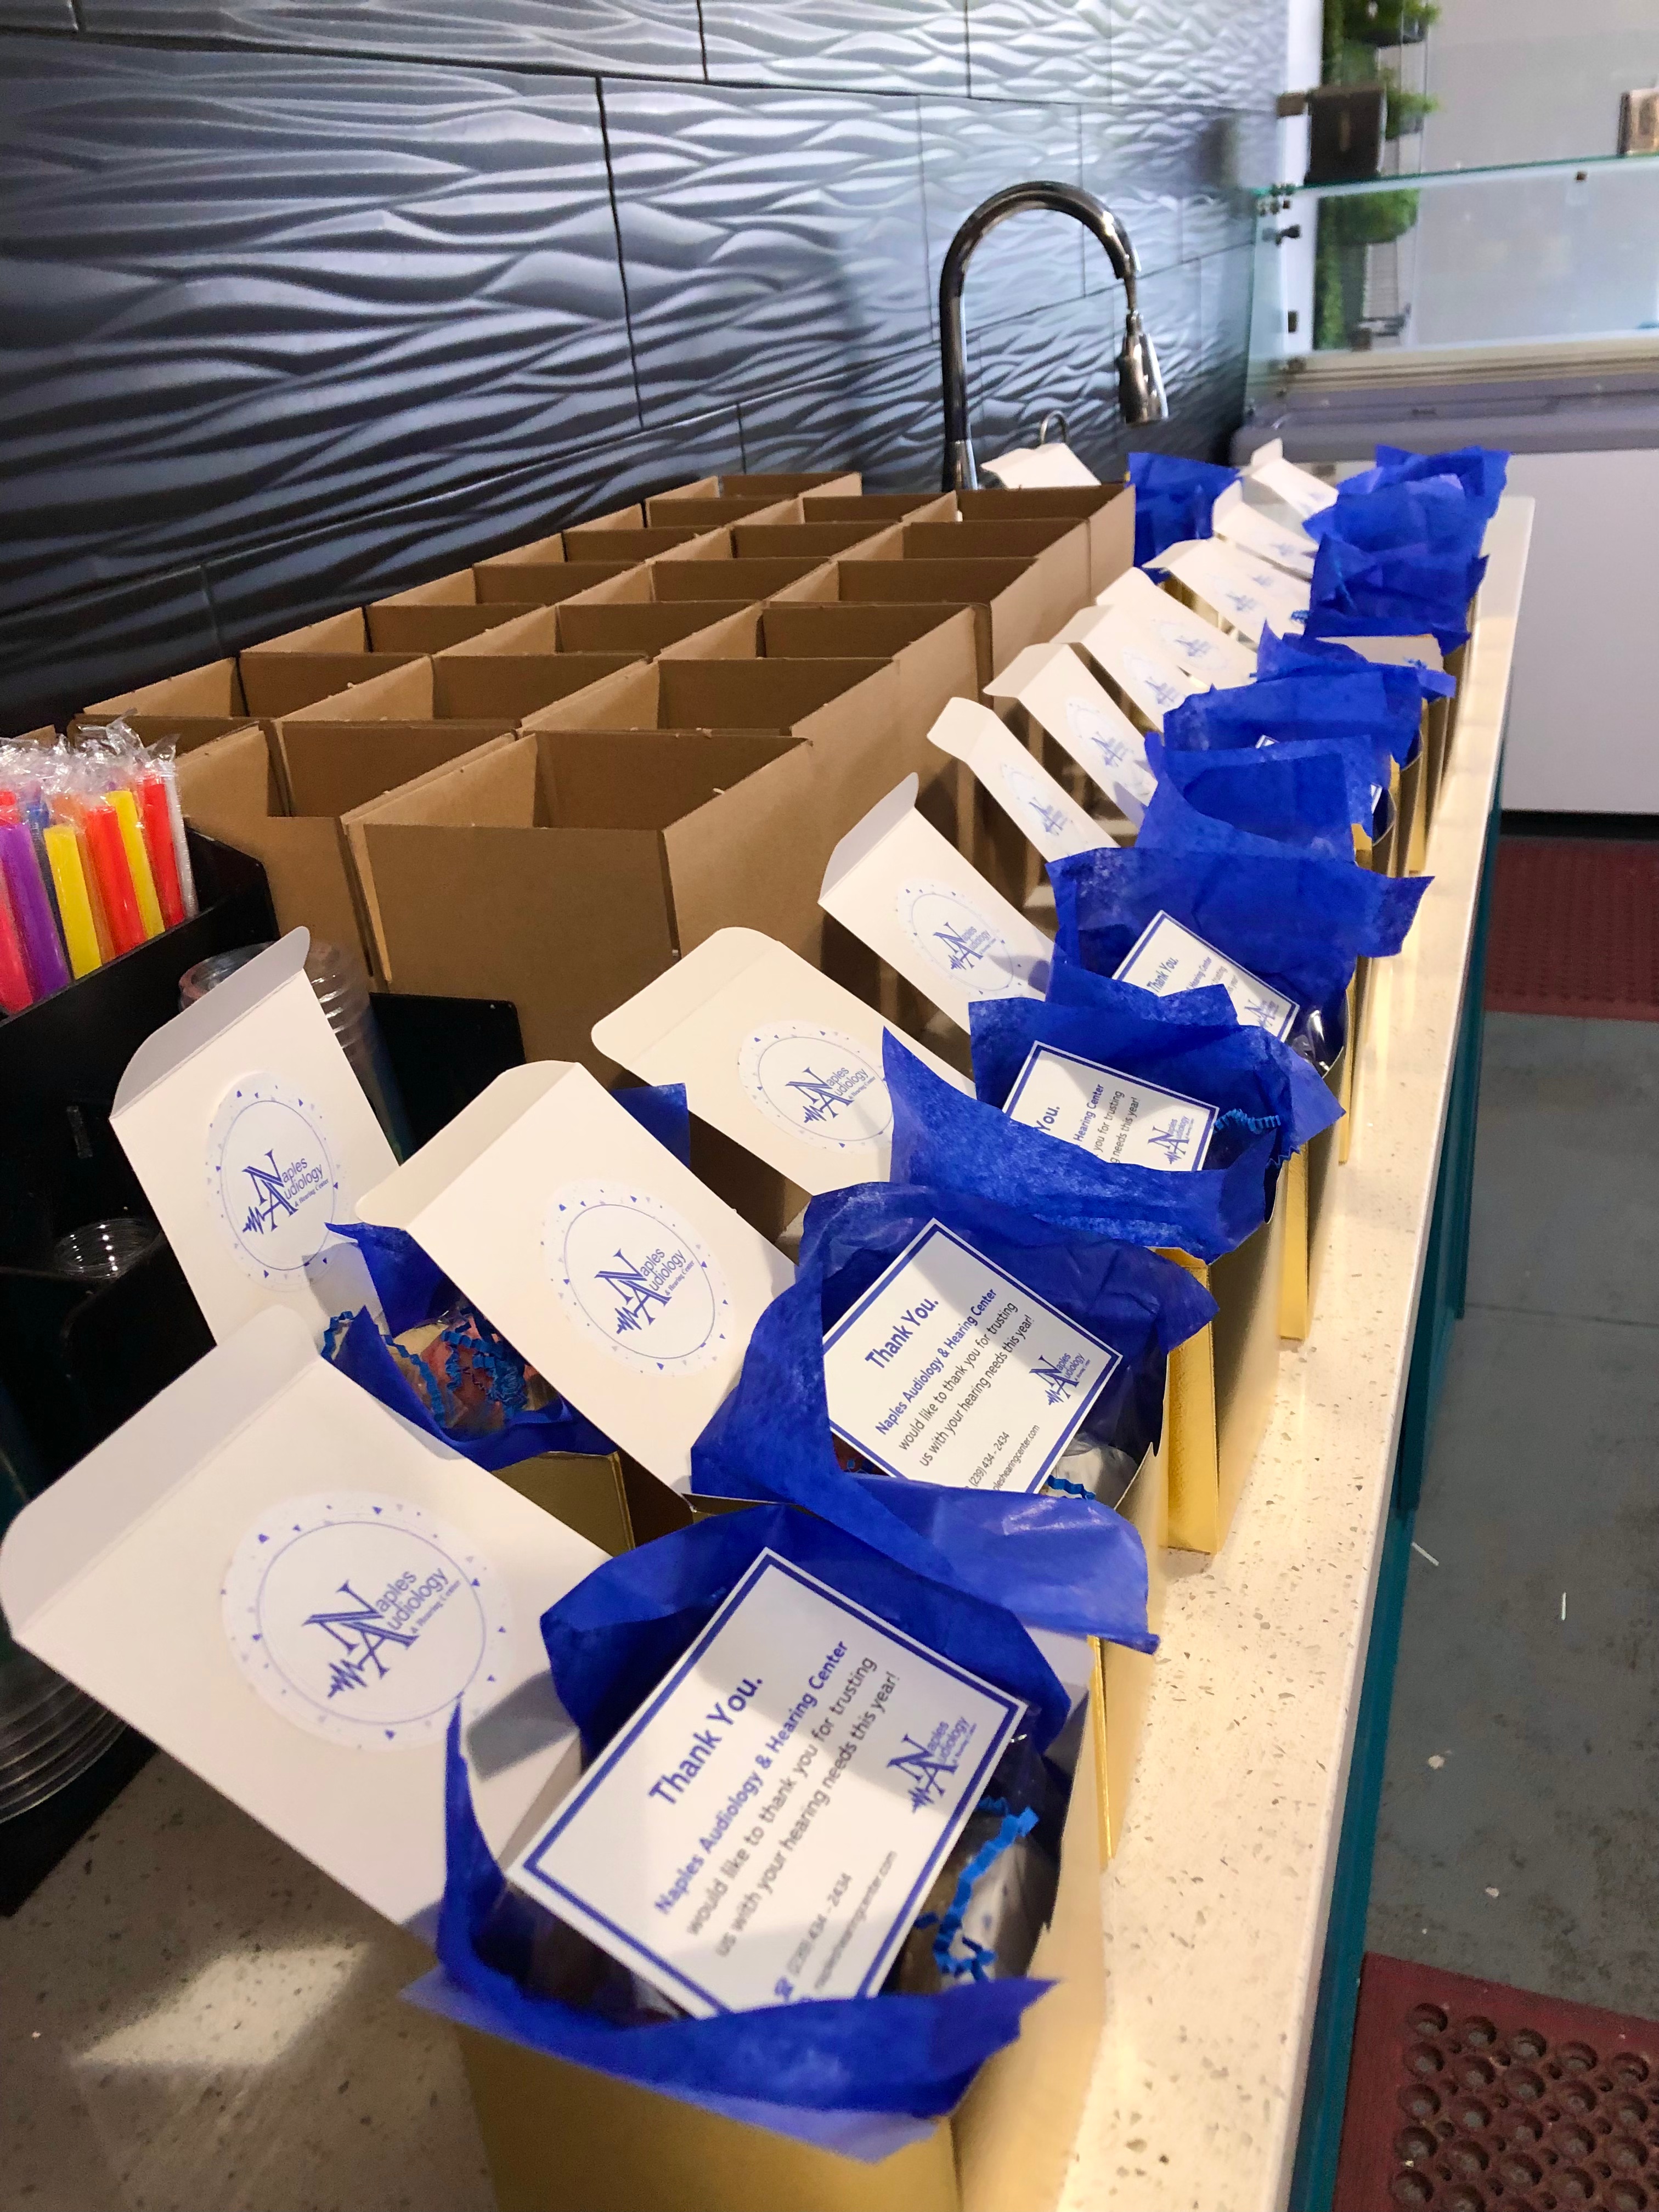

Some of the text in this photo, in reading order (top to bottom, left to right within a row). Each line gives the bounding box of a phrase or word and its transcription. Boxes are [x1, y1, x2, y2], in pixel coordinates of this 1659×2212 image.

[1147, 957, 1178, 992] Thank You.
[1034, 1107, 1060, 1131] You.
[1073, 1084, 1103, 1142] Hearing Center
[1093, 1091, 1125, 1152] you for trusting
[1113, 1133, 1127, 1156] needs
[1121, 1118, 1132, 1131] this
[1128, 1097, 1138, 1118] year!
[865, 1299, 938, 1368] Thank You.
[876, 1289, 996, 1435] Naples Audiology & Hearing Center
[899, 1303, 1018, 1450] would like to thank you for trusting
[919, 1314, 1031, 1466] us with your hearing needs this year!
[969, 1466, 987, 1487] (239)
[982, 1453, 995, 1468] 434
[994, 1432, 1009, 1451] 2434
[648, 1679, 763, 1804] Thank You.
[654, 1641, 847, 1914] Naples Audiology & Hearing Center
[687, 1657, 877, 1934] would like to thank you for trusting
[716, 1671, 900, 1956] us with your hearing needs this year!
